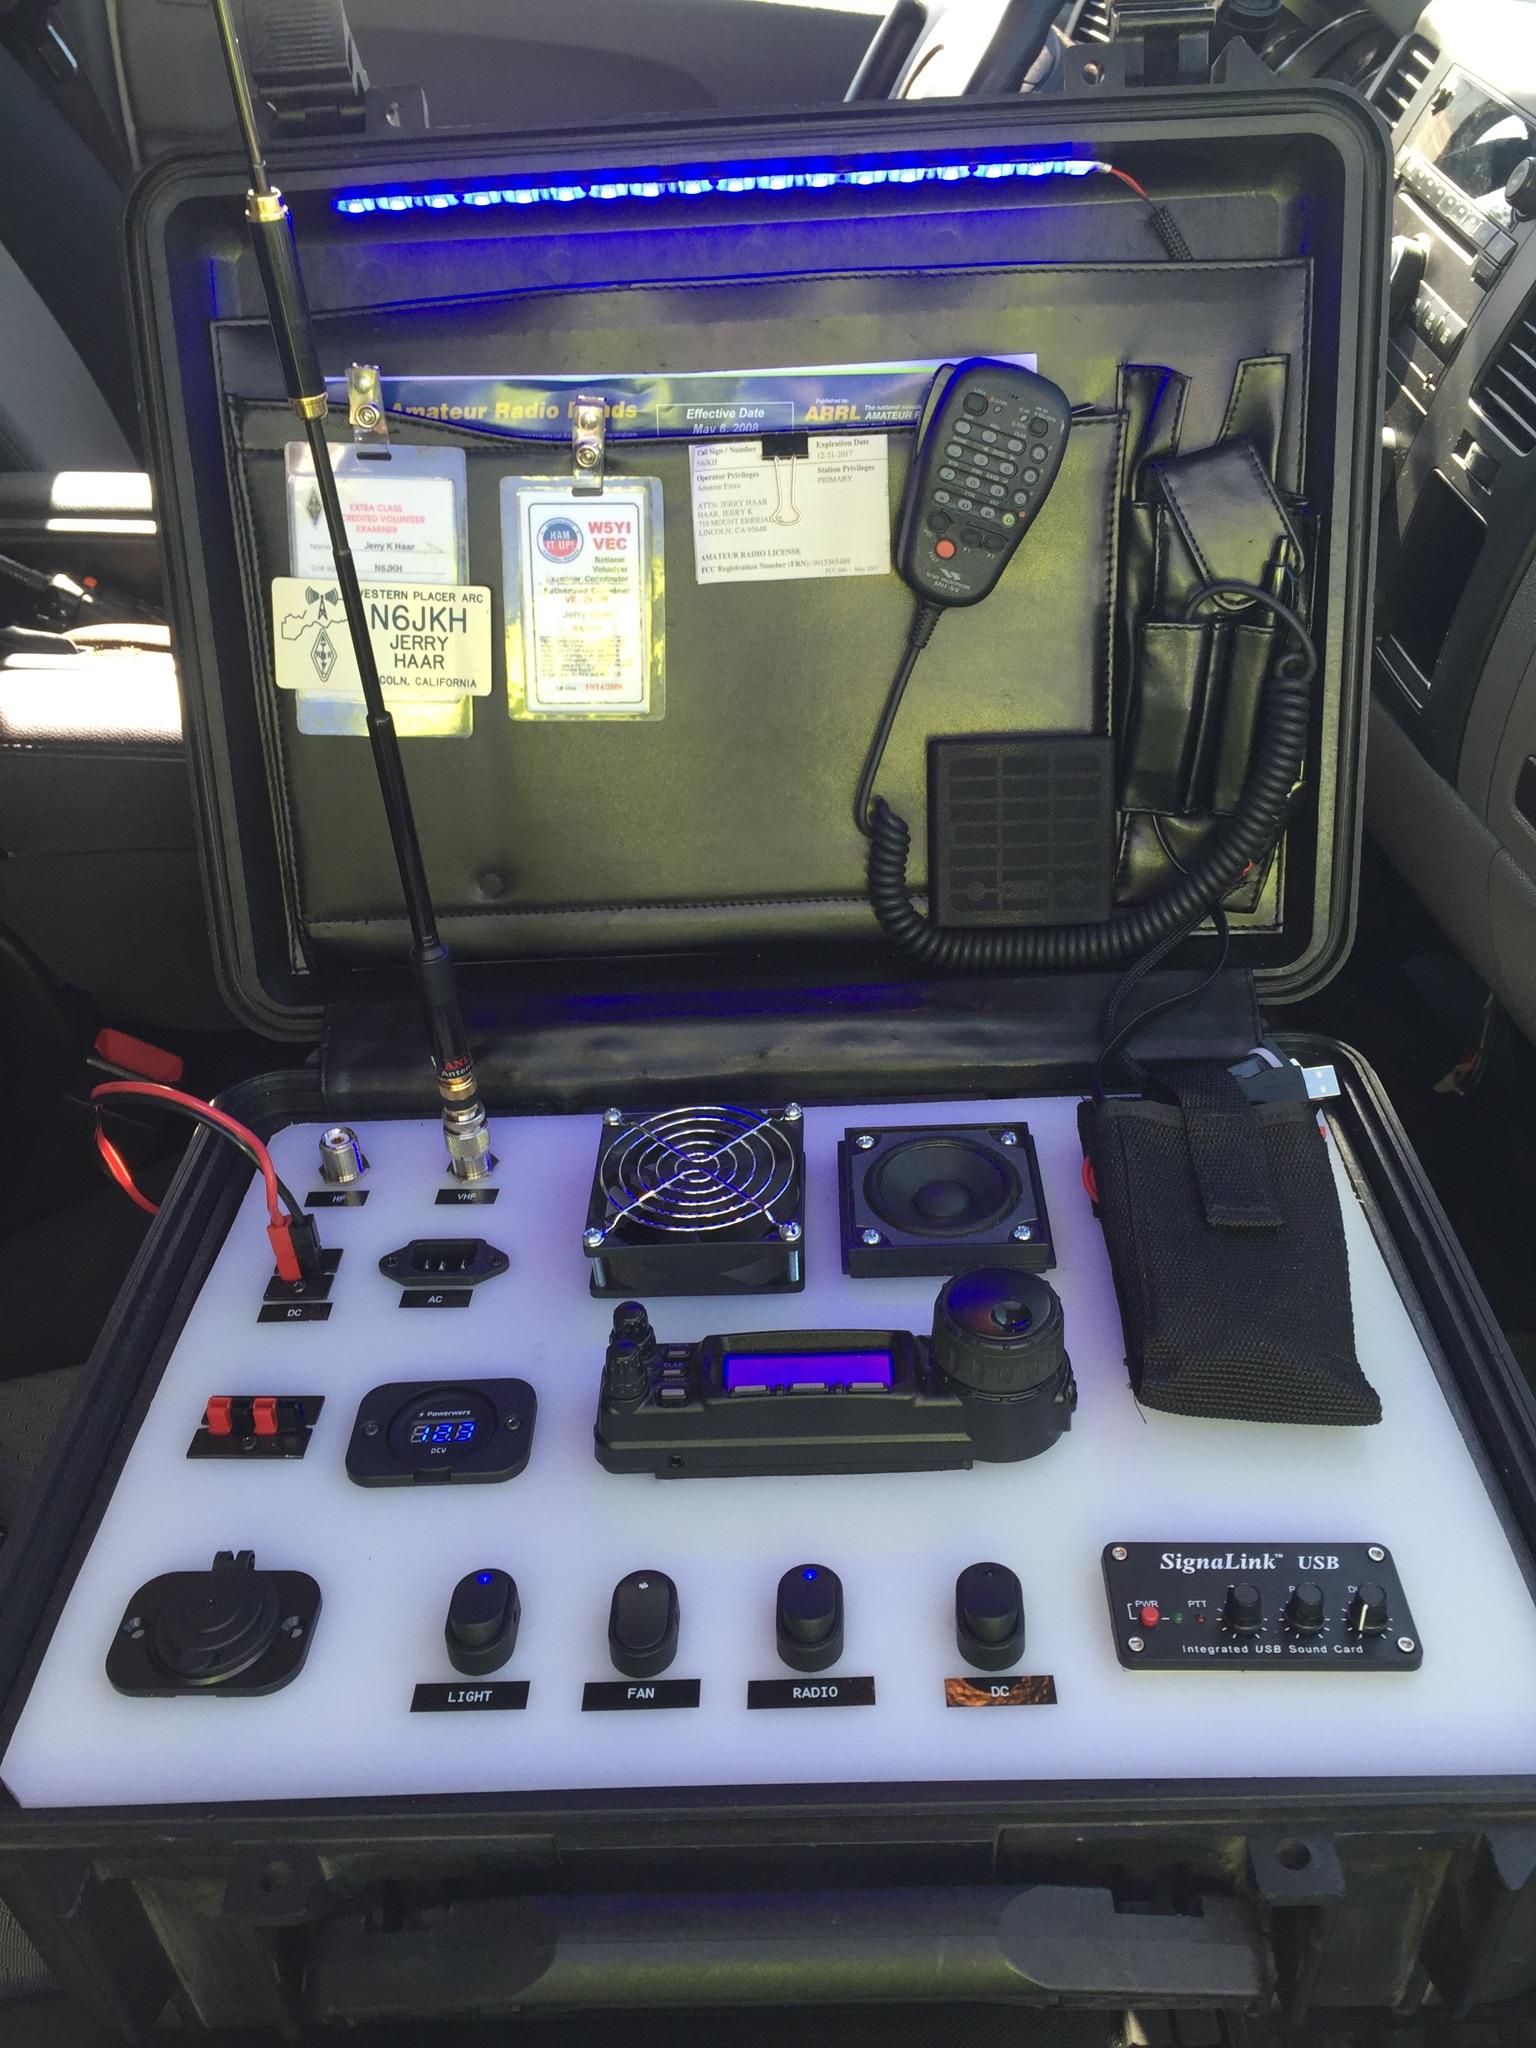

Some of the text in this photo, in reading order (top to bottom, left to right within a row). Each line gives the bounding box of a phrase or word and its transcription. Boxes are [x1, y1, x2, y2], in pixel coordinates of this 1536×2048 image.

[494, 400, 560, 420] Radio
[686, 407, 765, 420] Effective Date
[804, 405, 861, 421] ARRL
[864, 410, 914, 420] AMATEUR
[693, 424, 716, 434] May
[733, 422, 760, 432] 2008
[816, 440, 852, 448] Expiration
[350, 503, 402, 512] EXTRA CLASS
[342, 514, 426, 524] CREDITED VOLUNTEER
[356, 526, 398, 534] EXAMINER
[588, 521, 631, 534] W5YI
[550, 530, 570, 540] HAM
[364, 542, 384, 552] Jerry
[546, 541, 557, 550] IT
[592, 538, 628, 550] VEC
[740, 550, 766, 558] RADIO
[768, 548, 802, 556] LICENSE
[375, 564, 402, 573] N6JKH
[414, 591, 456, 602] PLACER
[462, 592, 484, 604] ARC
[372, 604, 468, 634] N6JKH
[390, 635, 449, 650] JERRY
[394, 654, 445, 670] HAAR
[379, 676, 478, 688] COLN, CALIFORNIA
[442, 1064, 471, 1078] Anten
[1298, 1556, 1340, 1570] USB
[1182, 1644, 1364, 1656] Integrated USB Sound Card
[448, 1690, 492, 1703] LIGHT
[627, 1688, 655, 1700] FAN
[792, 1686, 838, 1698] RADIO
[990, 1686, 1010, 1698] DC
